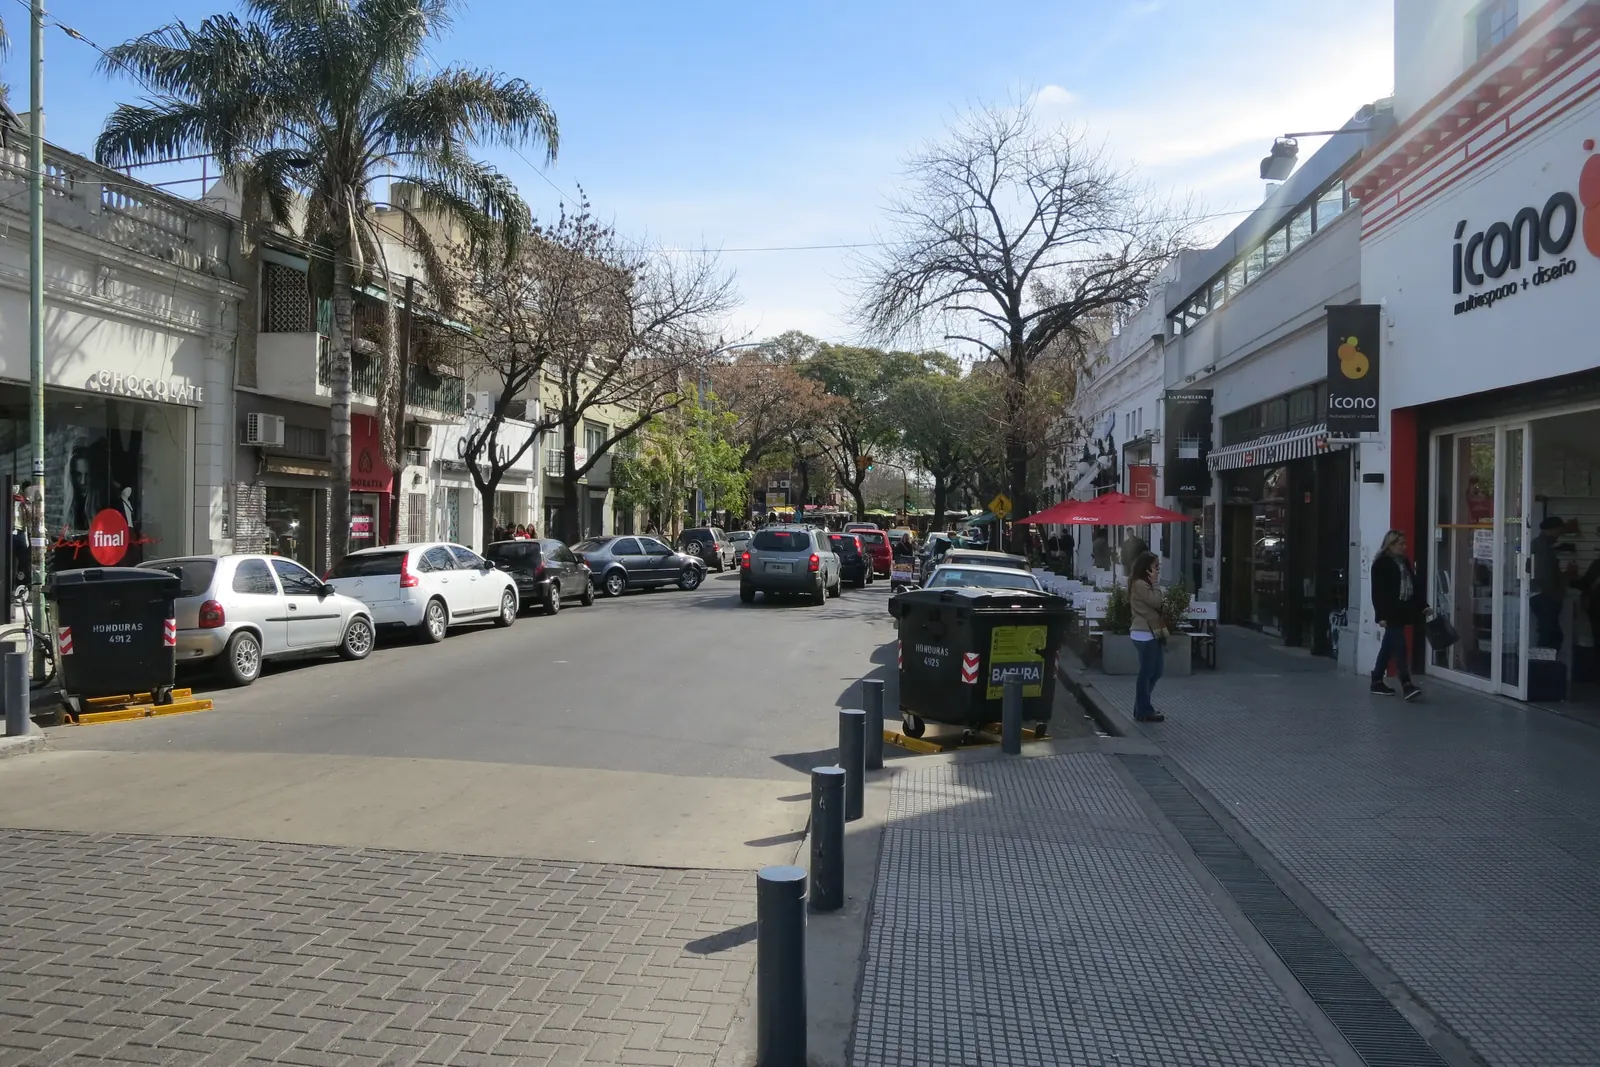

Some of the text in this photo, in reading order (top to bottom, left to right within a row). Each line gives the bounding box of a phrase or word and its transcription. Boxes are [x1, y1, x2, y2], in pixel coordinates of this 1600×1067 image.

[1453, 192, 1577, 294] ícono
[1532, 257, 1577, 286] diseño
[99, 369, 204, 402] CHOCOLATE
[1329, 393, 1376, 409] ícono
[94, 530, 125, 547] final
[92, 622, 143, 633] HONDURAS
[109, 634, 132, 643] 4912
[915, 643, 949, 657] HONDURAS
[923, 656, 940, 667] 4925
